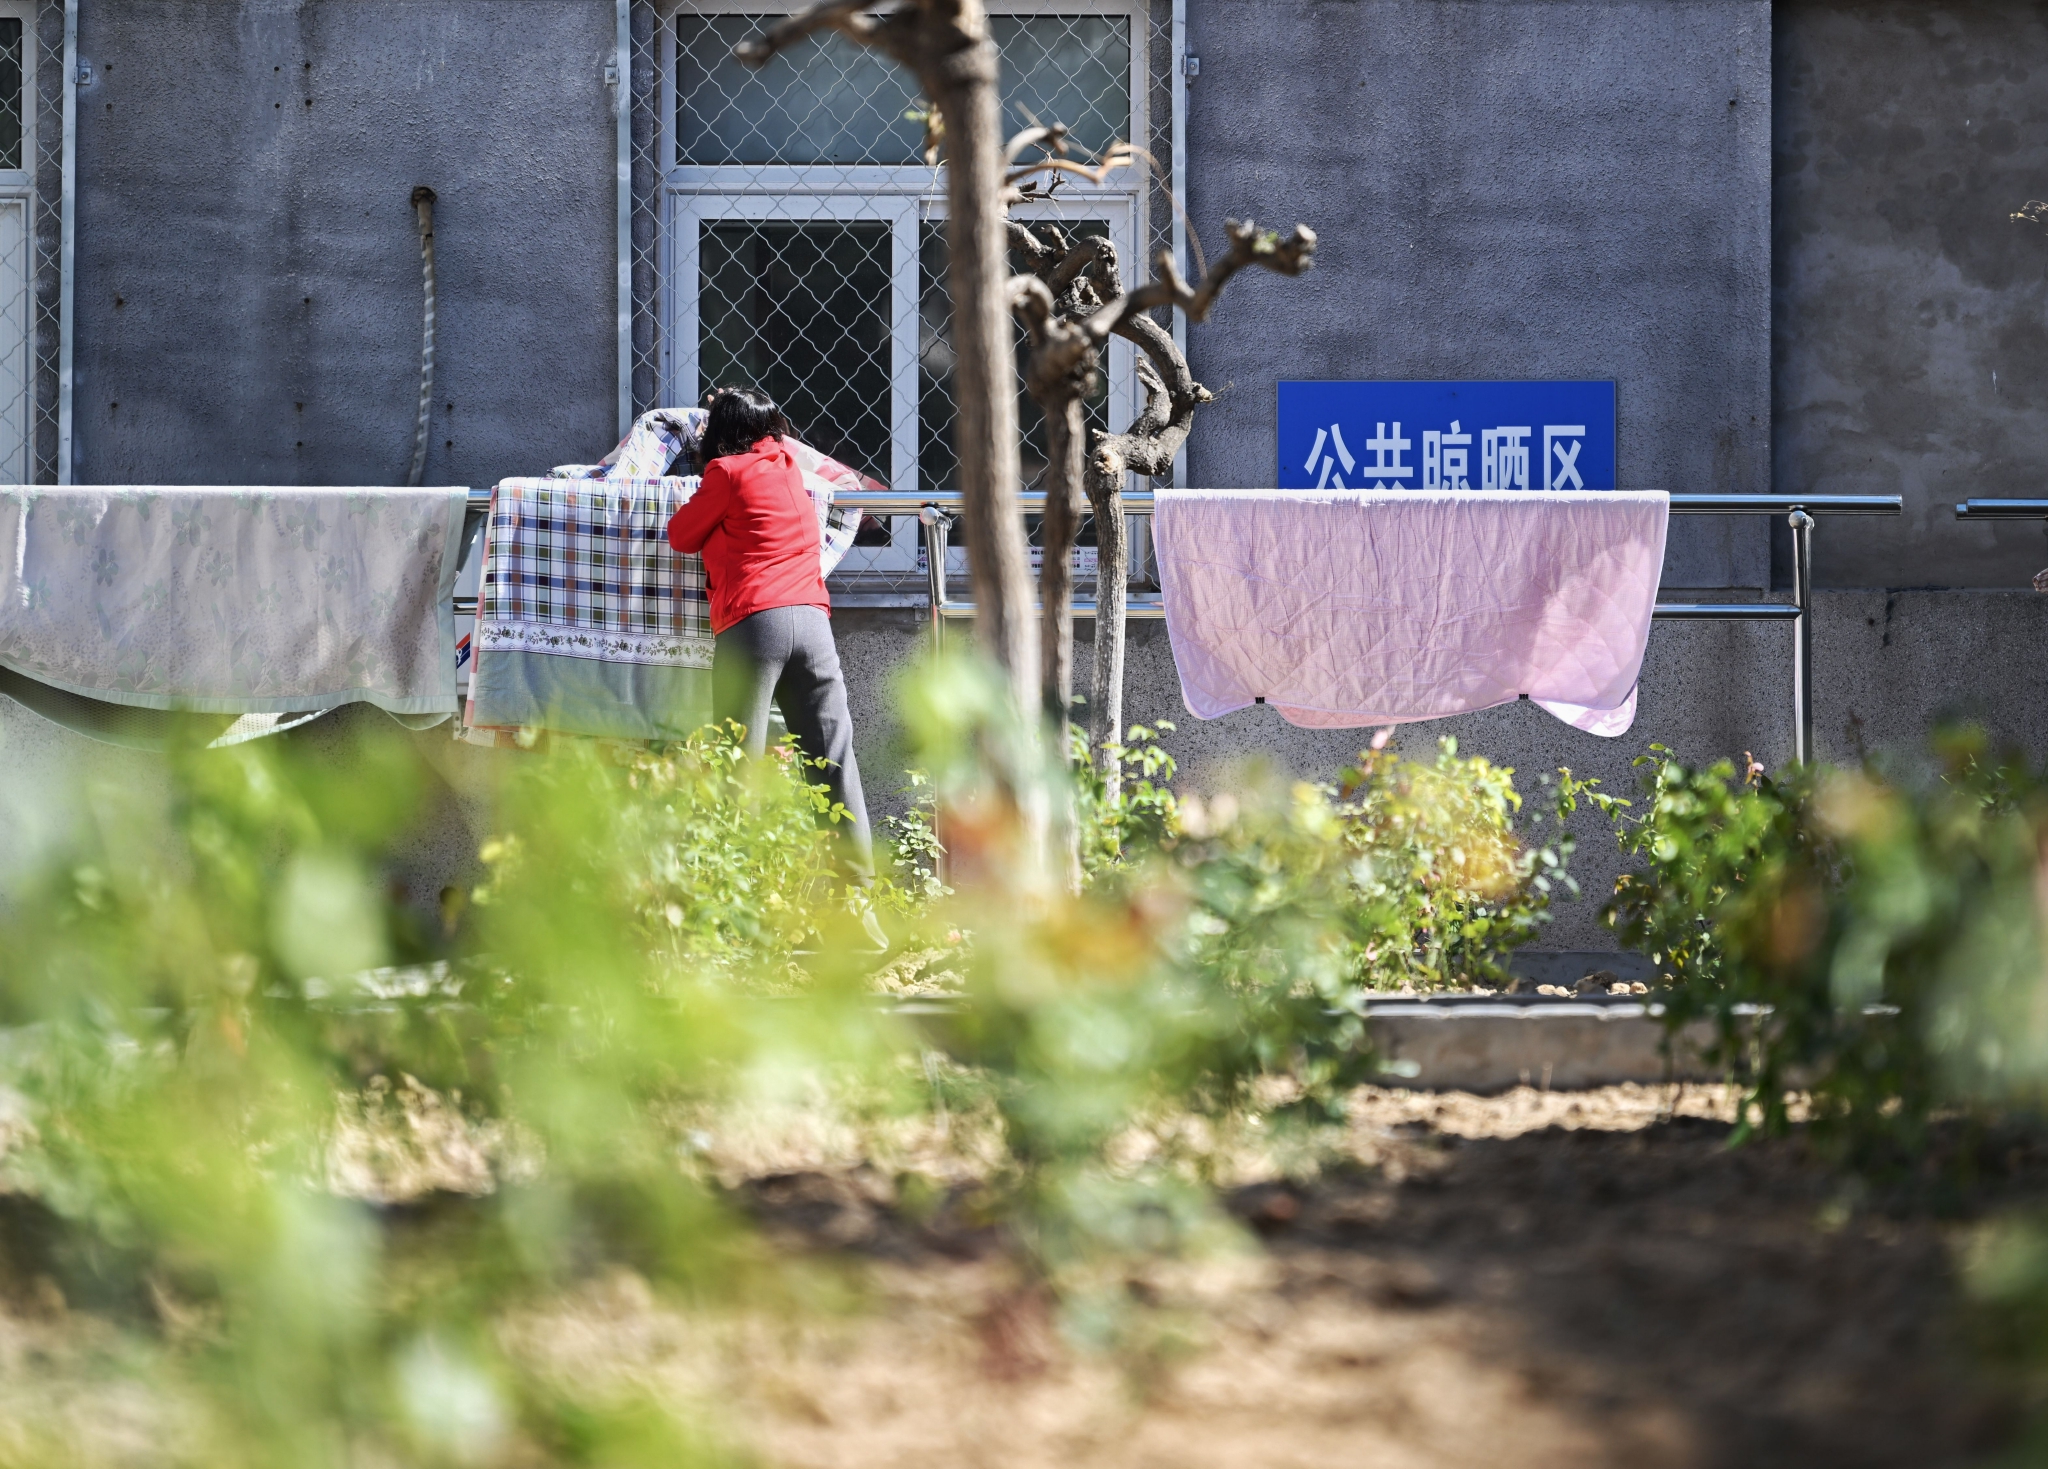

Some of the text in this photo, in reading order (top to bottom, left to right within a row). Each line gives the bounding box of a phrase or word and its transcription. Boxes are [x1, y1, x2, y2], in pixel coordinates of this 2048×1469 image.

[1304, 420, 1586, 490] 公共晾晒区
